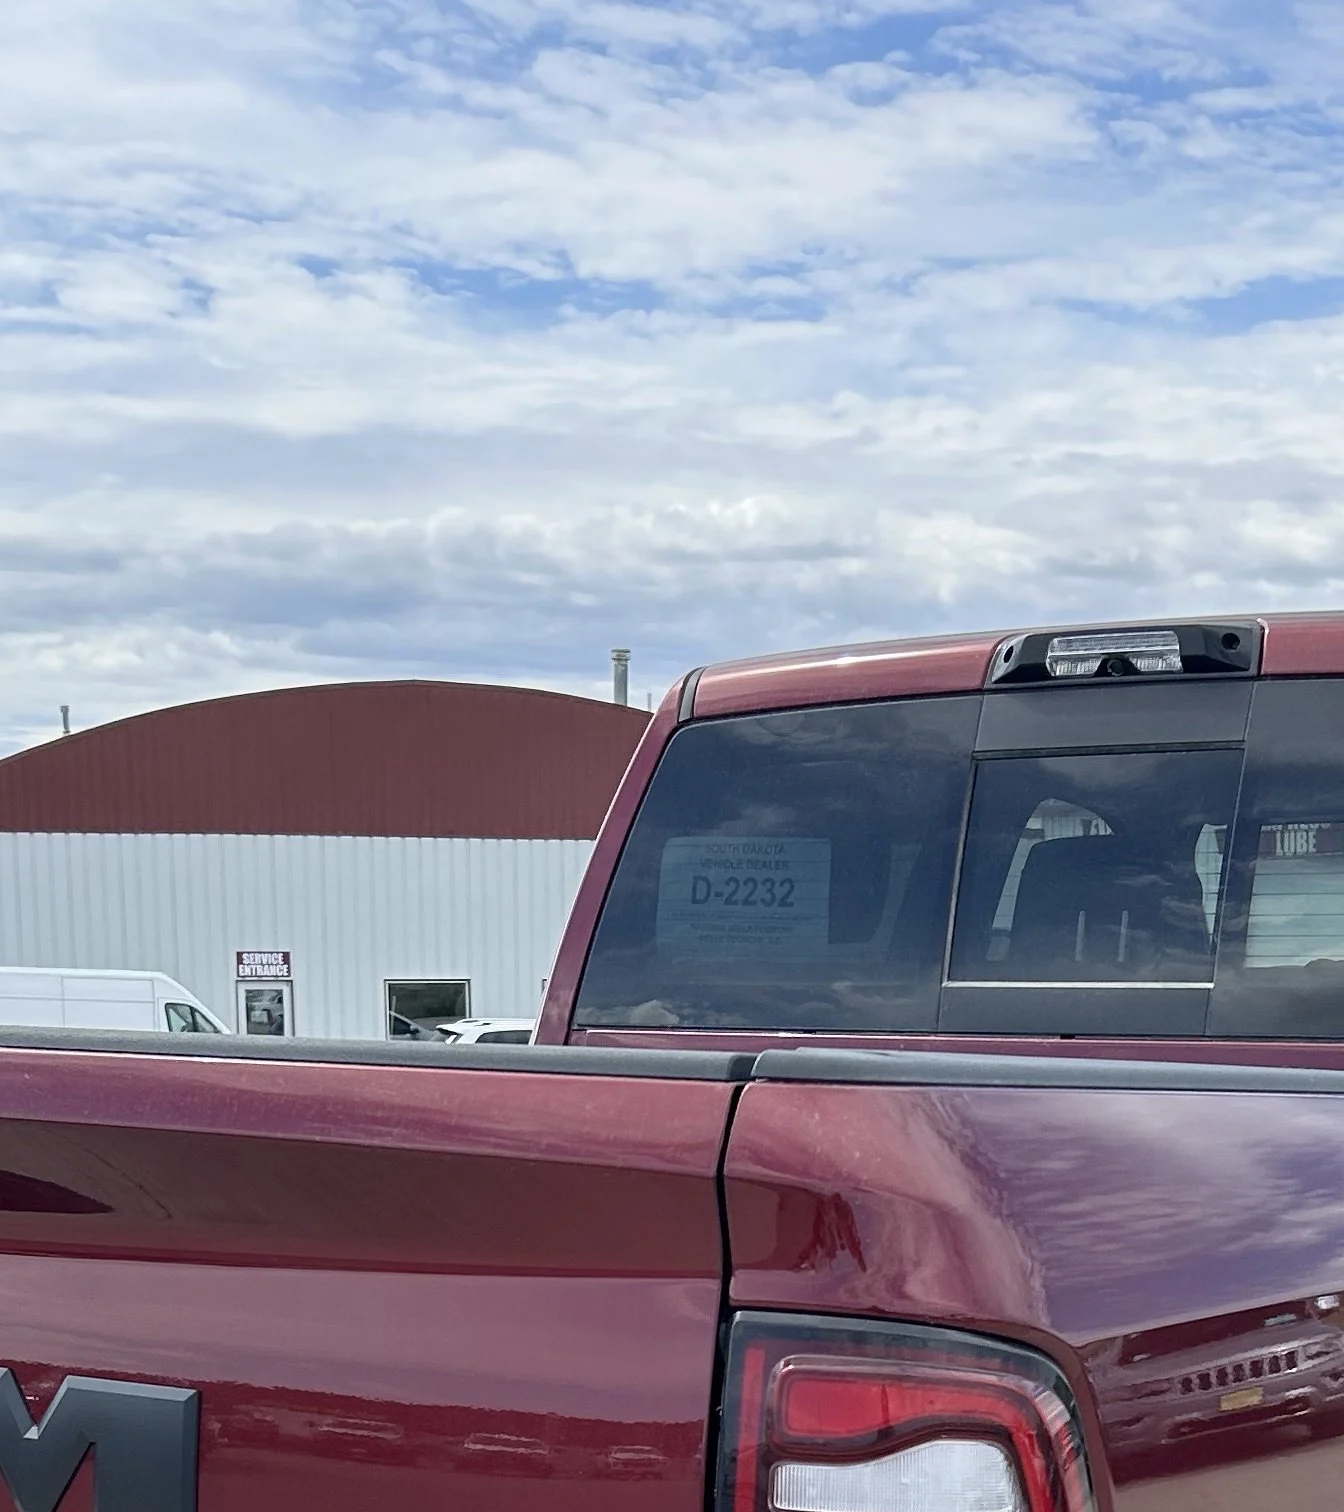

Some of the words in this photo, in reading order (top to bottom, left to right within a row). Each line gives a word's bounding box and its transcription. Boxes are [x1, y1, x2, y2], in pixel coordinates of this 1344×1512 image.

[743, 843, 785, 855] DAKOTA
[1276, 831, 1317, 856] LUBE
[699, 858, 745, 870] VEHICLE
[746, 859, 790, 871] DEALER
[690, 874, 795, 908] D-2232
[242, 953, 284, 964] SERVICE
[239, 965, 288, 976] ENTRANCE
